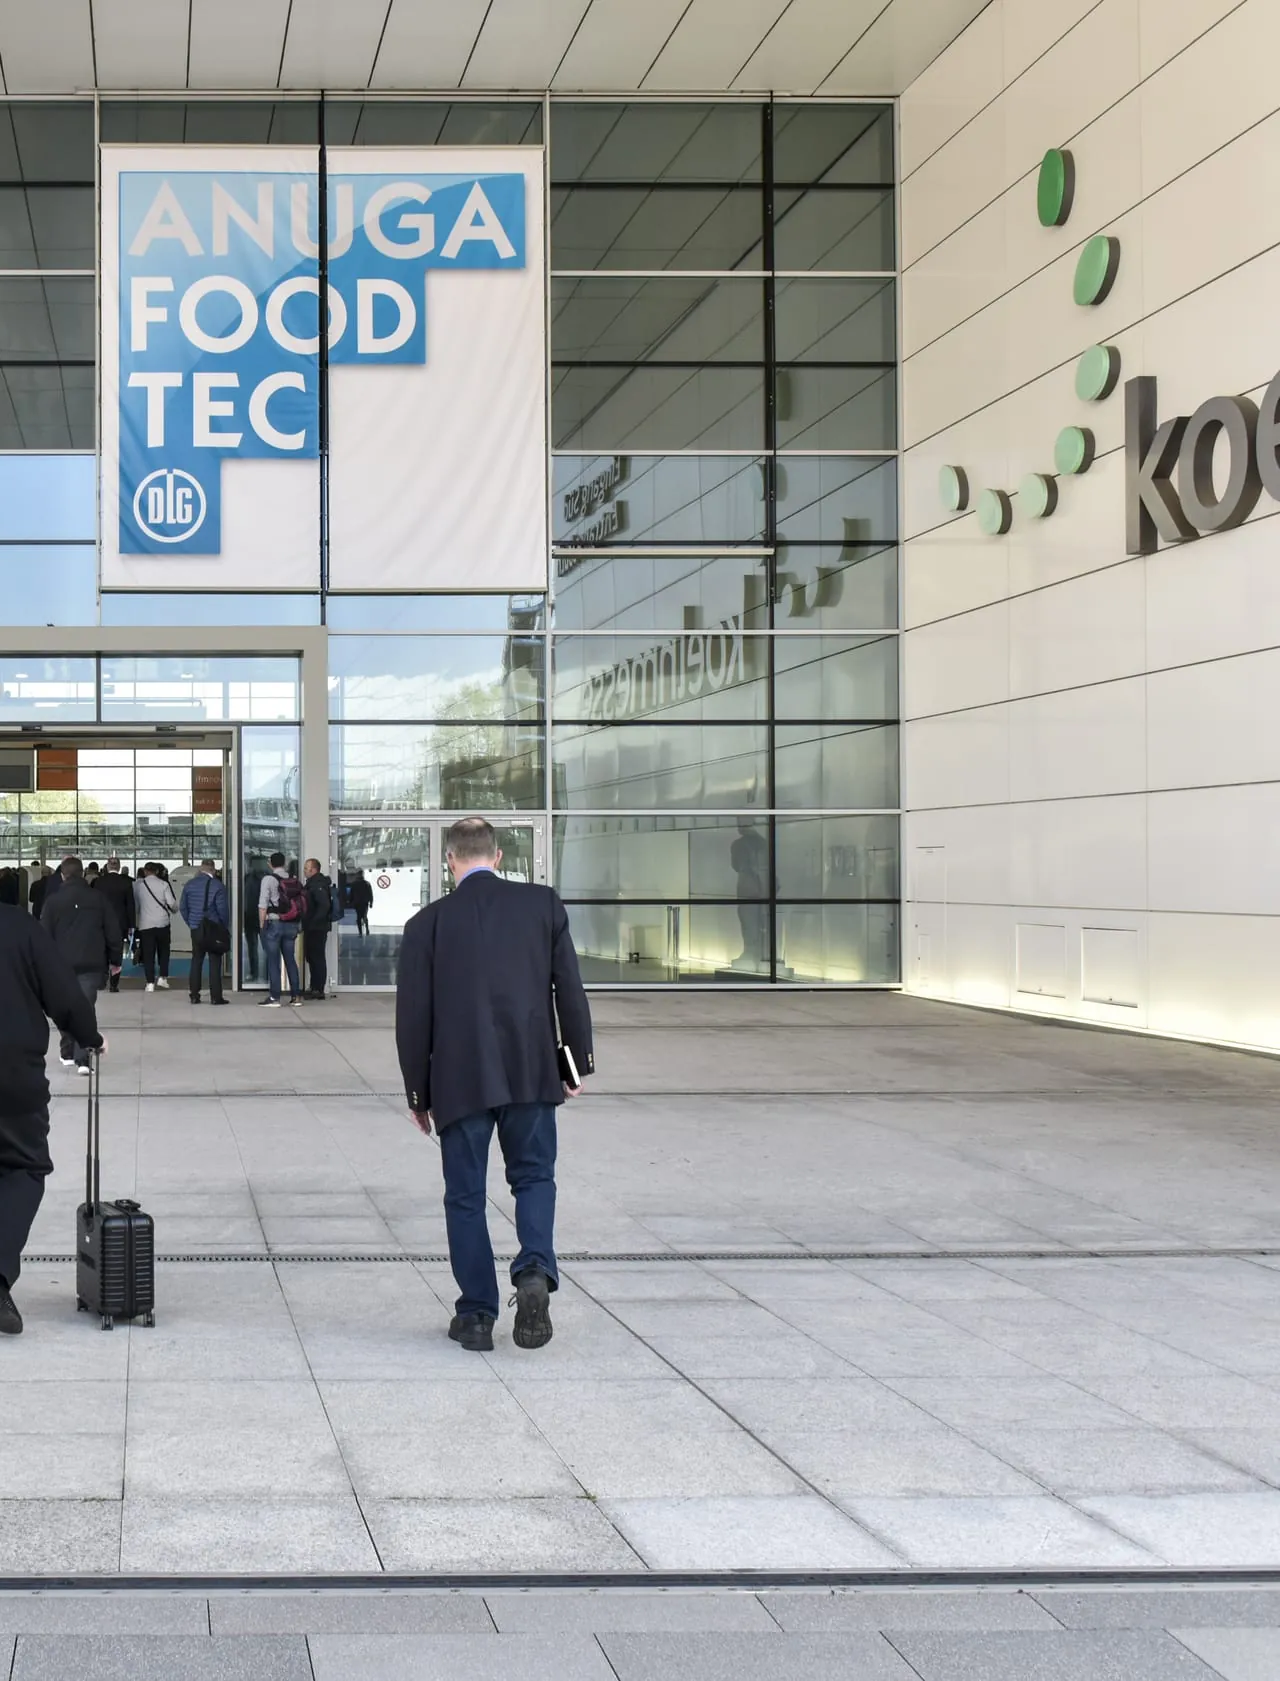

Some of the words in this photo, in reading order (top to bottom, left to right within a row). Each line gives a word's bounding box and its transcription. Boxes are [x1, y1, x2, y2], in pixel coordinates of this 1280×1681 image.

[127, 179, 516, 260] ANUGA
[130, 275, 417, 355] FOOD
[127, 371, 307, 450] TEC
[1124, 368, 1280, 555] ko
